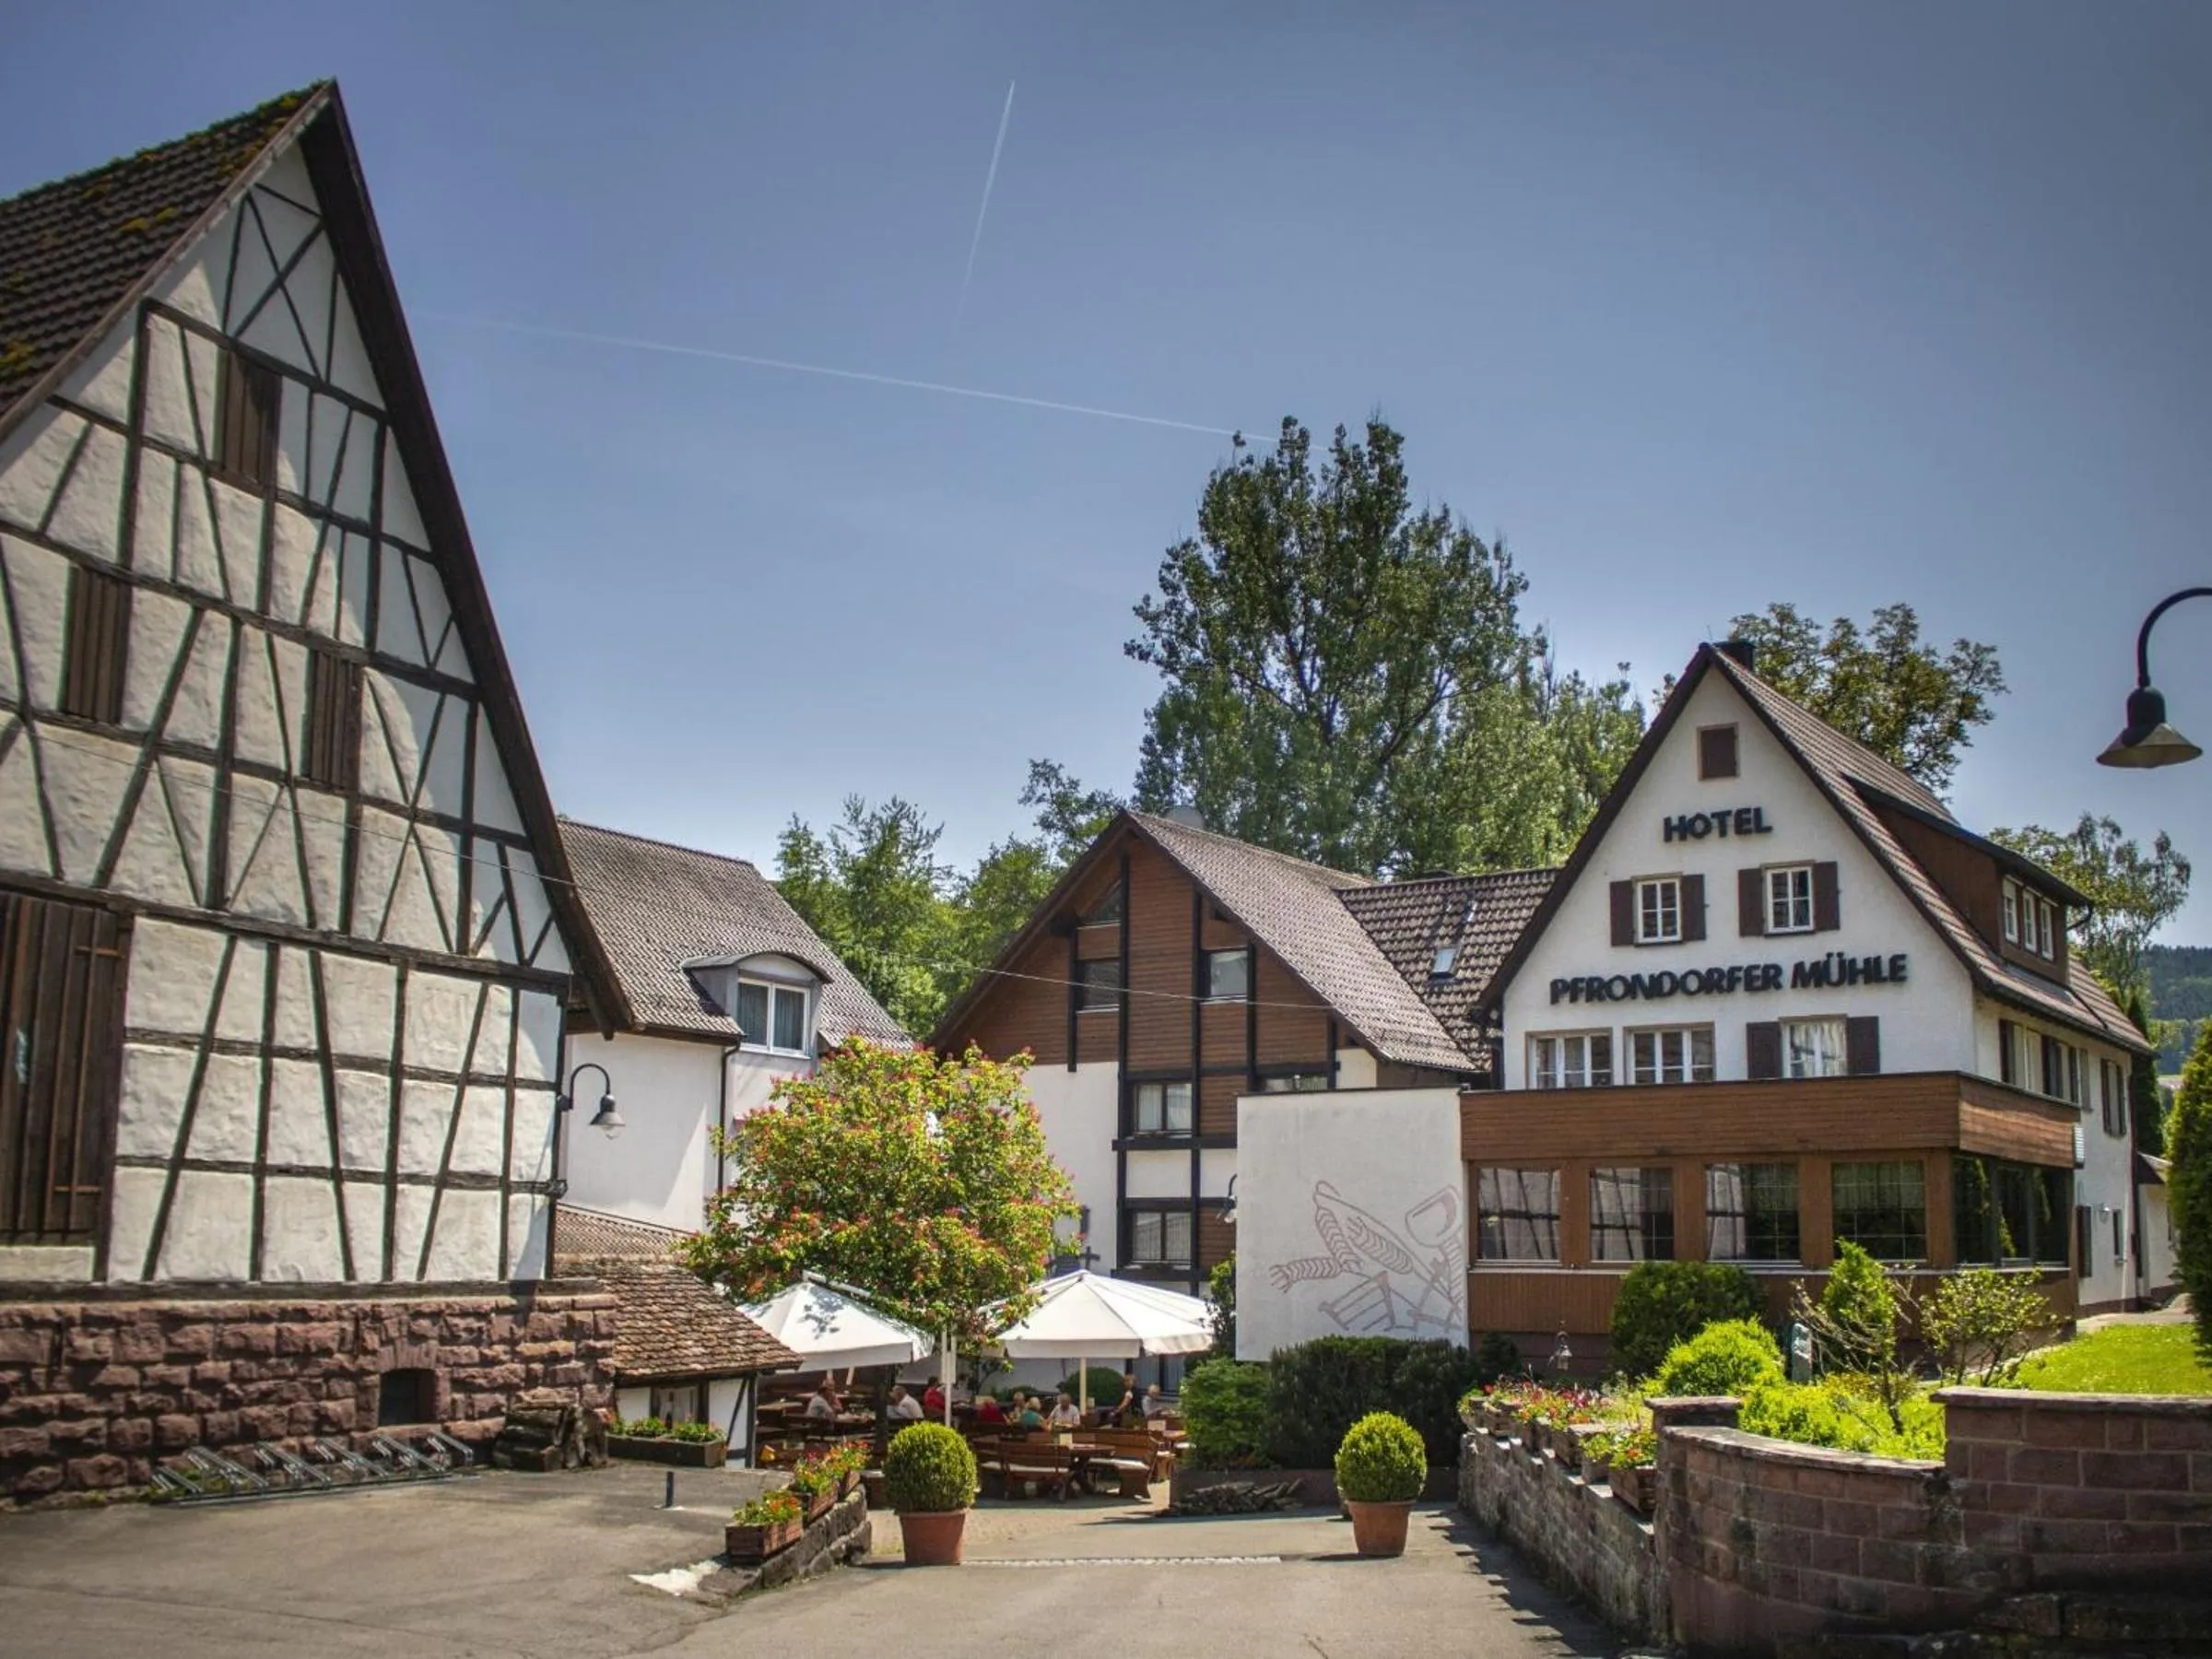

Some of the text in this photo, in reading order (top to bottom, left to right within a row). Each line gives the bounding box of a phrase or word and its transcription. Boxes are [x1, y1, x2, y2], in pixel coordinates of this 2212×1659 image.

[1664, 806, 1772, 842] HOTEL
[1550, 952, 1908, 1005] PFRONDORFER MÜHLE
